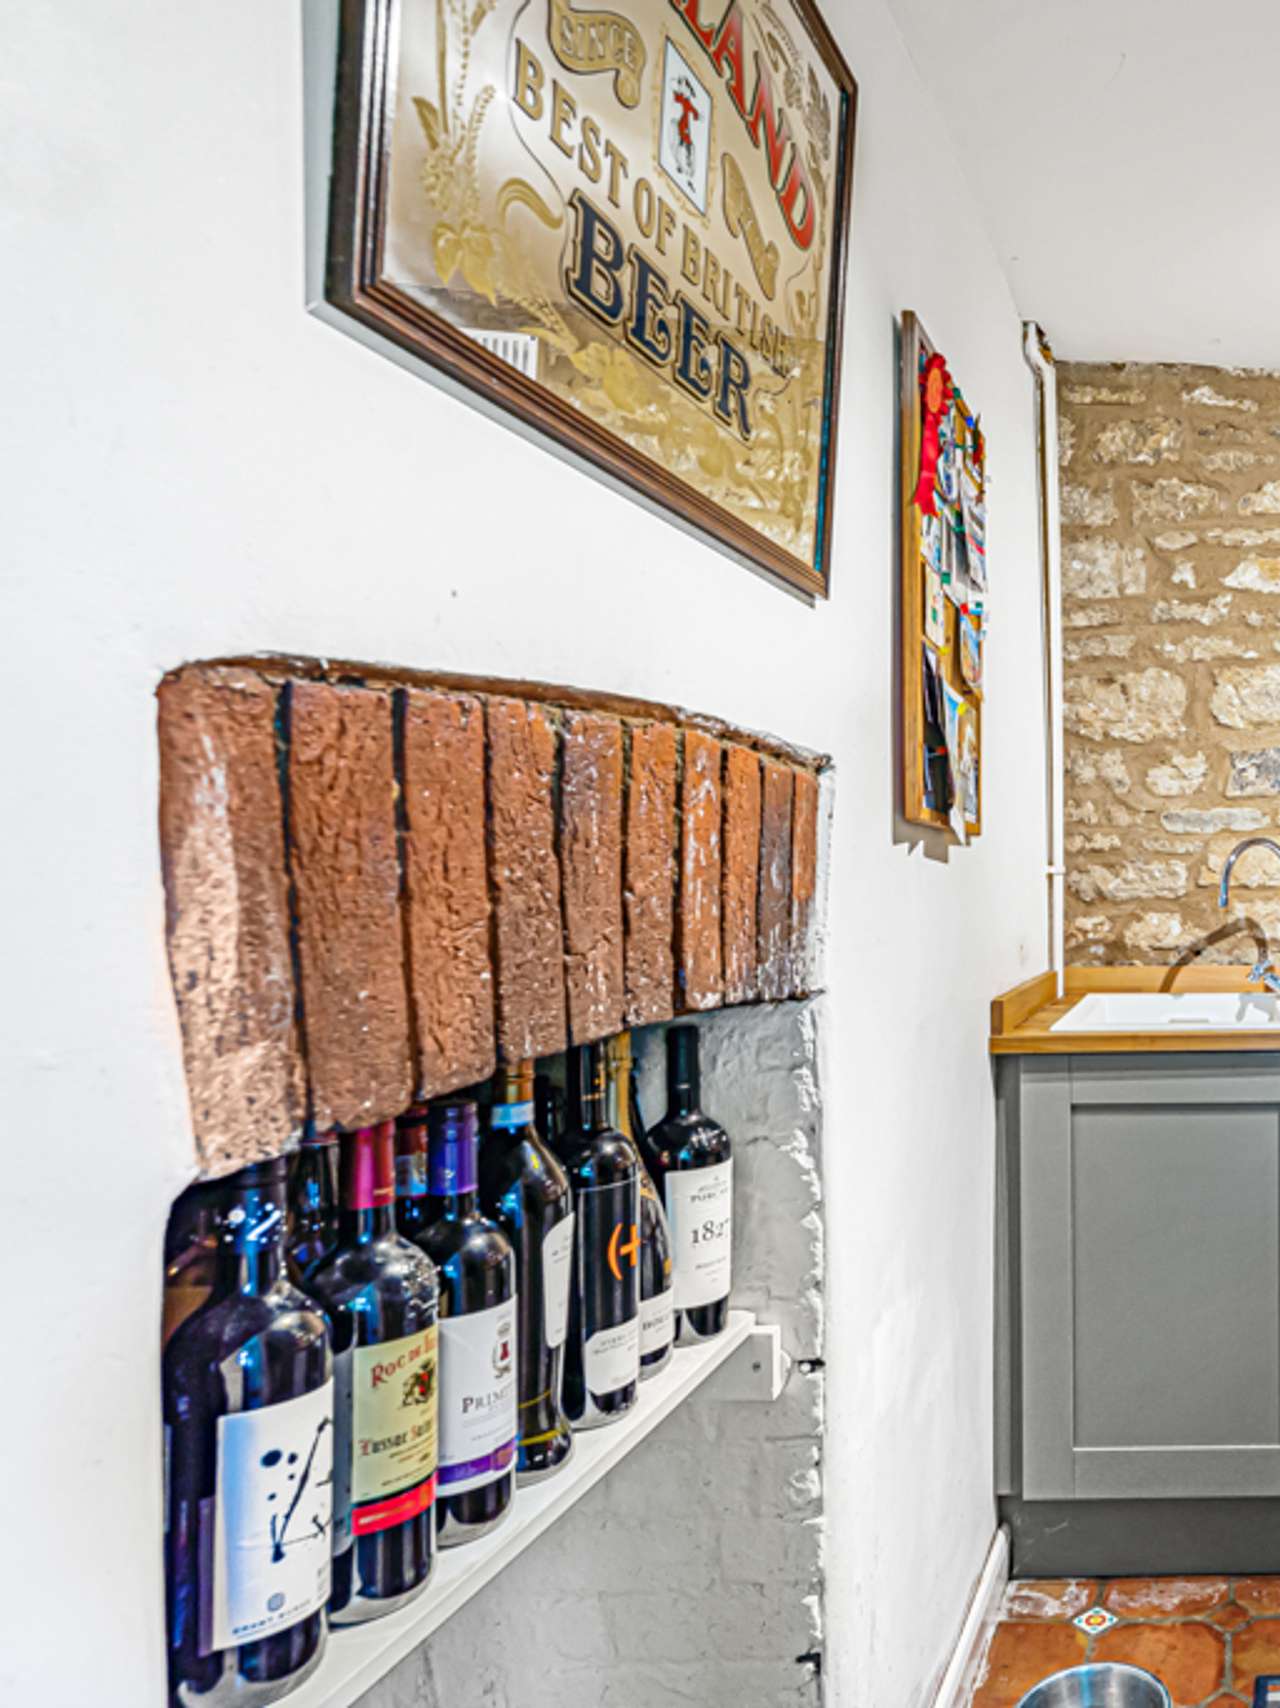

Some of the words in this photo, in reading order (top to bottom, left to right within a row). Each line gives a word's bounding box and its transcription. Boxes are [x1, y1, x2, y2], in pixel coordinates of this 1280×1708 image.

[560, 14, 637, 68] SINCE
[514, 38, 629, 208] BEST
[632, 177, 677, 257] OF
[679, 224, 788, 378] BRITISH
[565, 188, 751, 441] BEER
